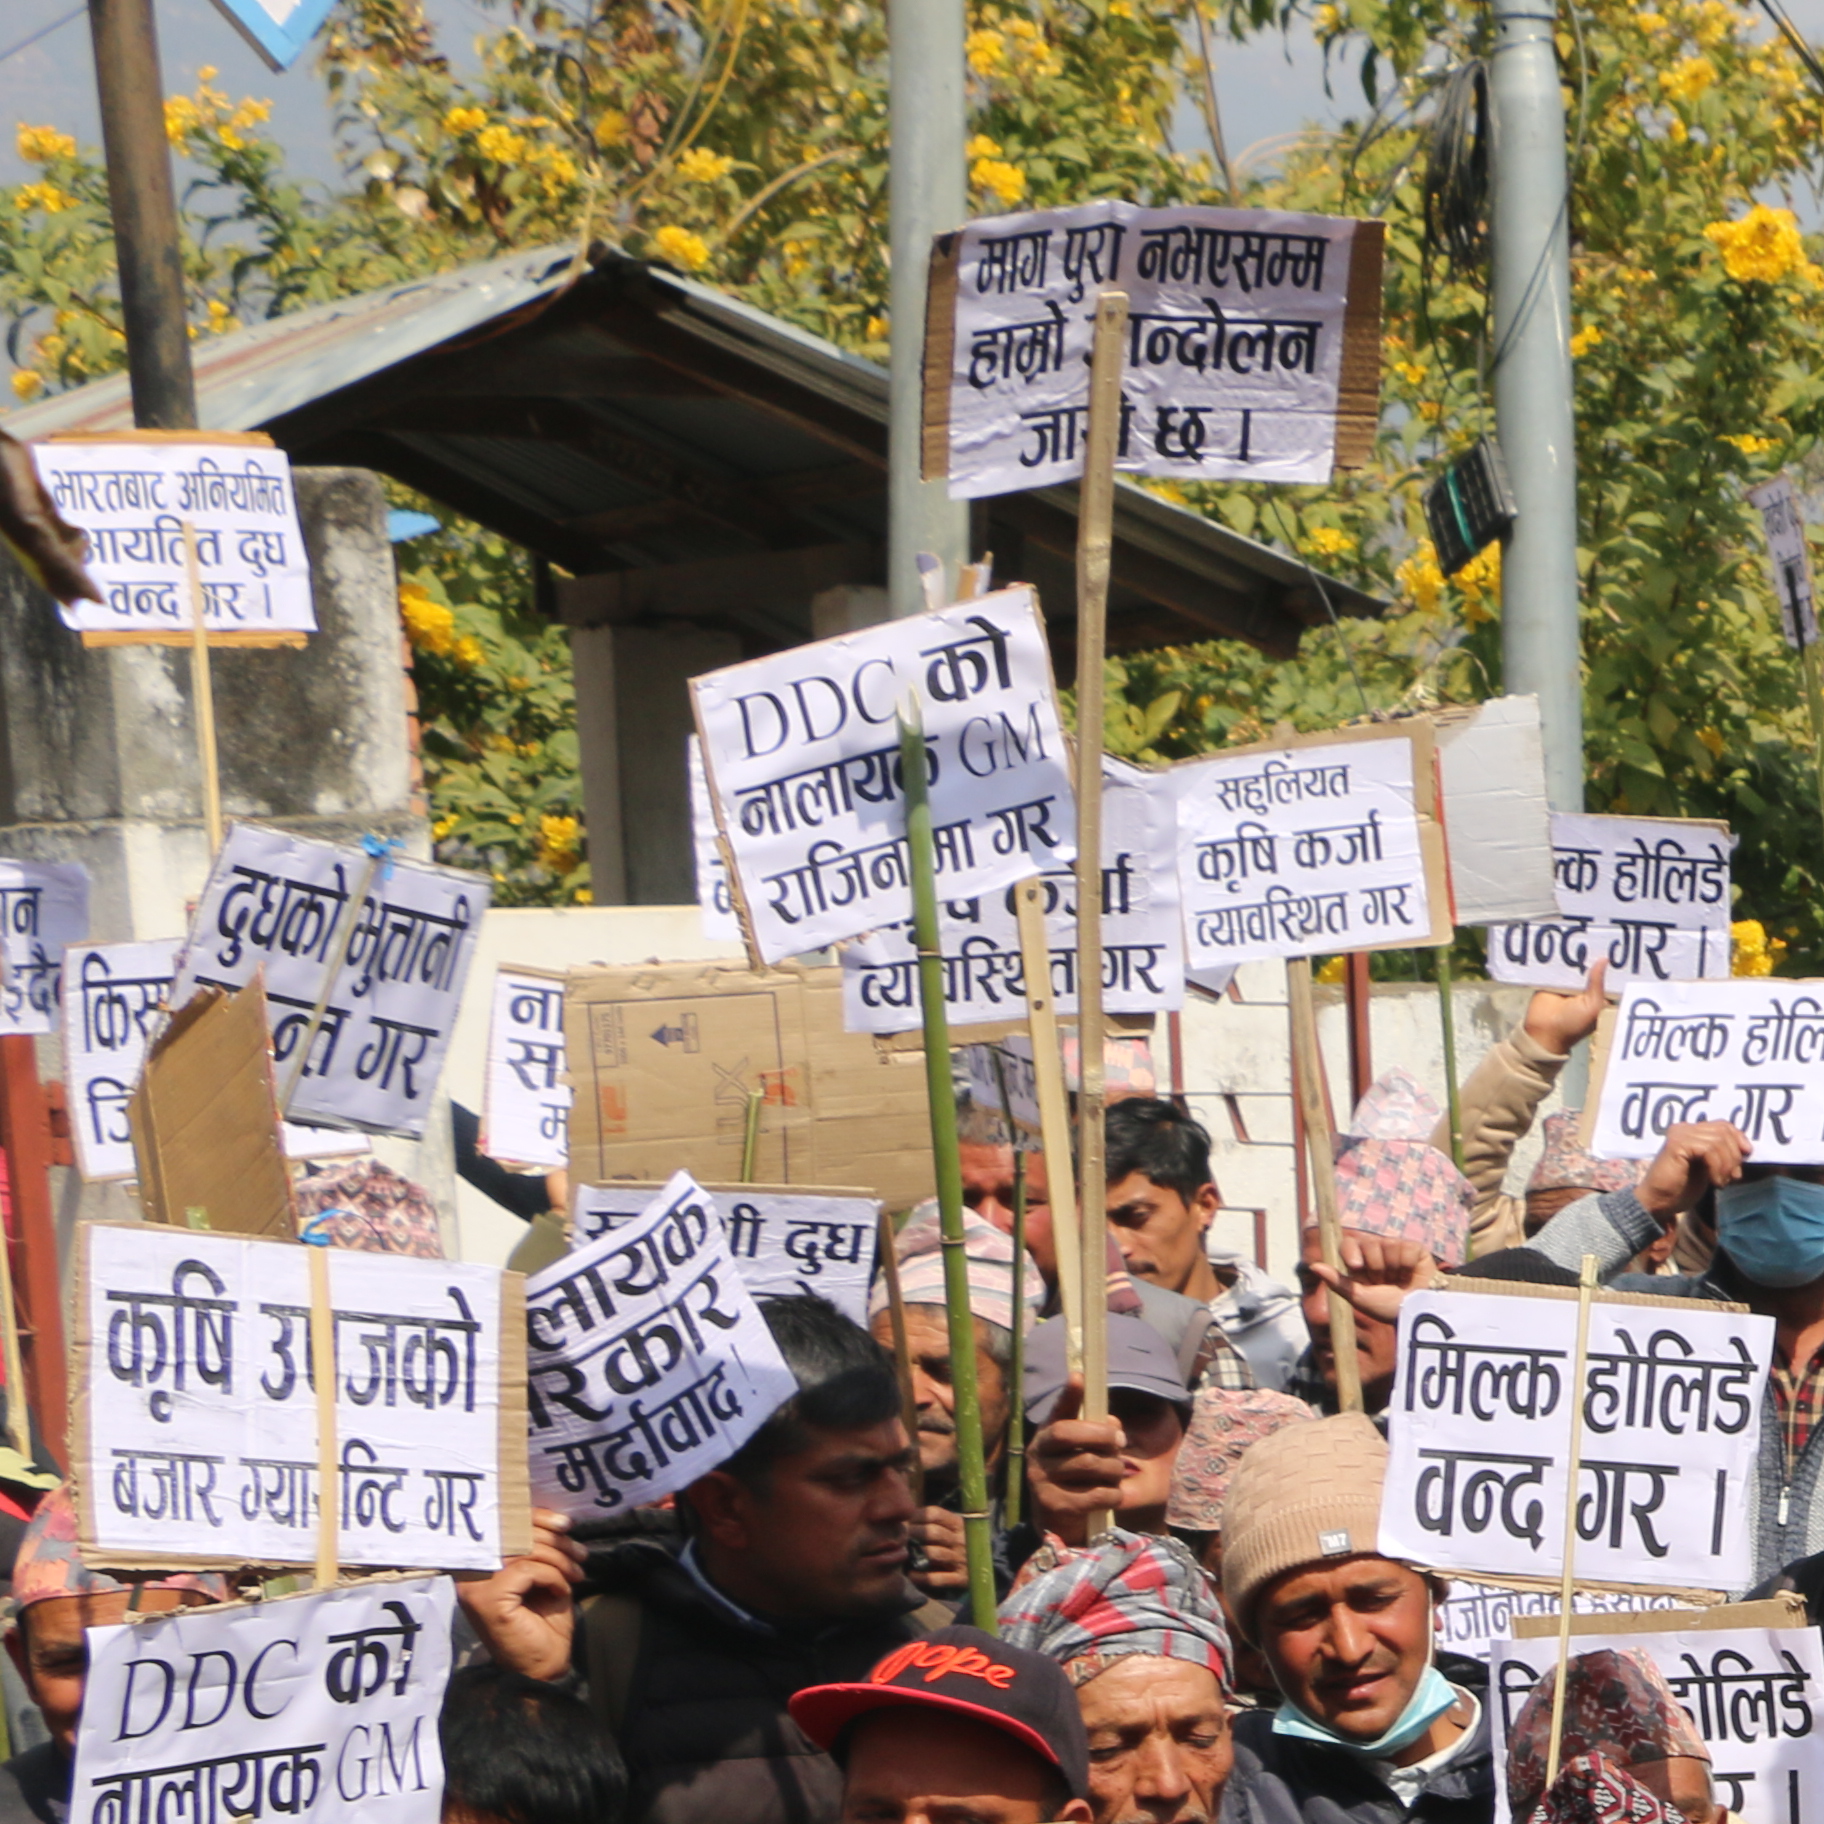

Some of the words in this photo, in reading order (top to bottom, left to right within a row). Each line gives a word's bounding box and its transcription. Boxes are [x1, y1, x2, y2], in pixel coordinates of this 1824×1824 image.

[976, 229, 1052, 294] माग
[1062, 222, 1127, 303] पुरा
[1138, 226, 1330, 293] नभएसम्म
[967, 300, 1069, 389] हाम्रो
[1084, 297, 1323, 373] न्दोलन
[1155, 406, 1212, 460] छ
[53, 466, 165, 512] भारतबाट
[178, 458, 288, 519] अनियमित
[239, 526, 287, 579] दुध
[110, 583, 179, 620] वन्द
[731, 658, 896, 761] DDC
[920, 615, 1012, 702] को
[958, 702, 1052, 778] GM
[987, 796, 1062, 855] गर
[1195, 821, 1277, 893] कृषि
[1293, 808, 1382, 868] कर्जा
[1360, 884, 1414, 926] गर
[1612, 838, 1729, 904] होलिडे
[217, 863, 354, 969] दुधको
[356, 1016, 439, 1100] गर
[1621, 1000, 1735, 1064] मिल्क
[784, 1219, 870, 1275] दुध
[106, 1259, 238, 1423] कृषि
[259, 1286, 482, 1413] उजको
[1404, 1312, 1567, 1422] मिल्क
[1581, 1329, 1759, 1435] होलिडे
[112, 1448, 226, 1529] बजार
[424, 1469, 486, 1542] गर
[1415, 1448, 1554, 1551] वन्द
[1575, 1459, 1681, 1558] गर
[112, 1638, 301, 1743] DDC
[325, 1600, 423, 1705] को
[337, 1715, 430, 1803] GM
